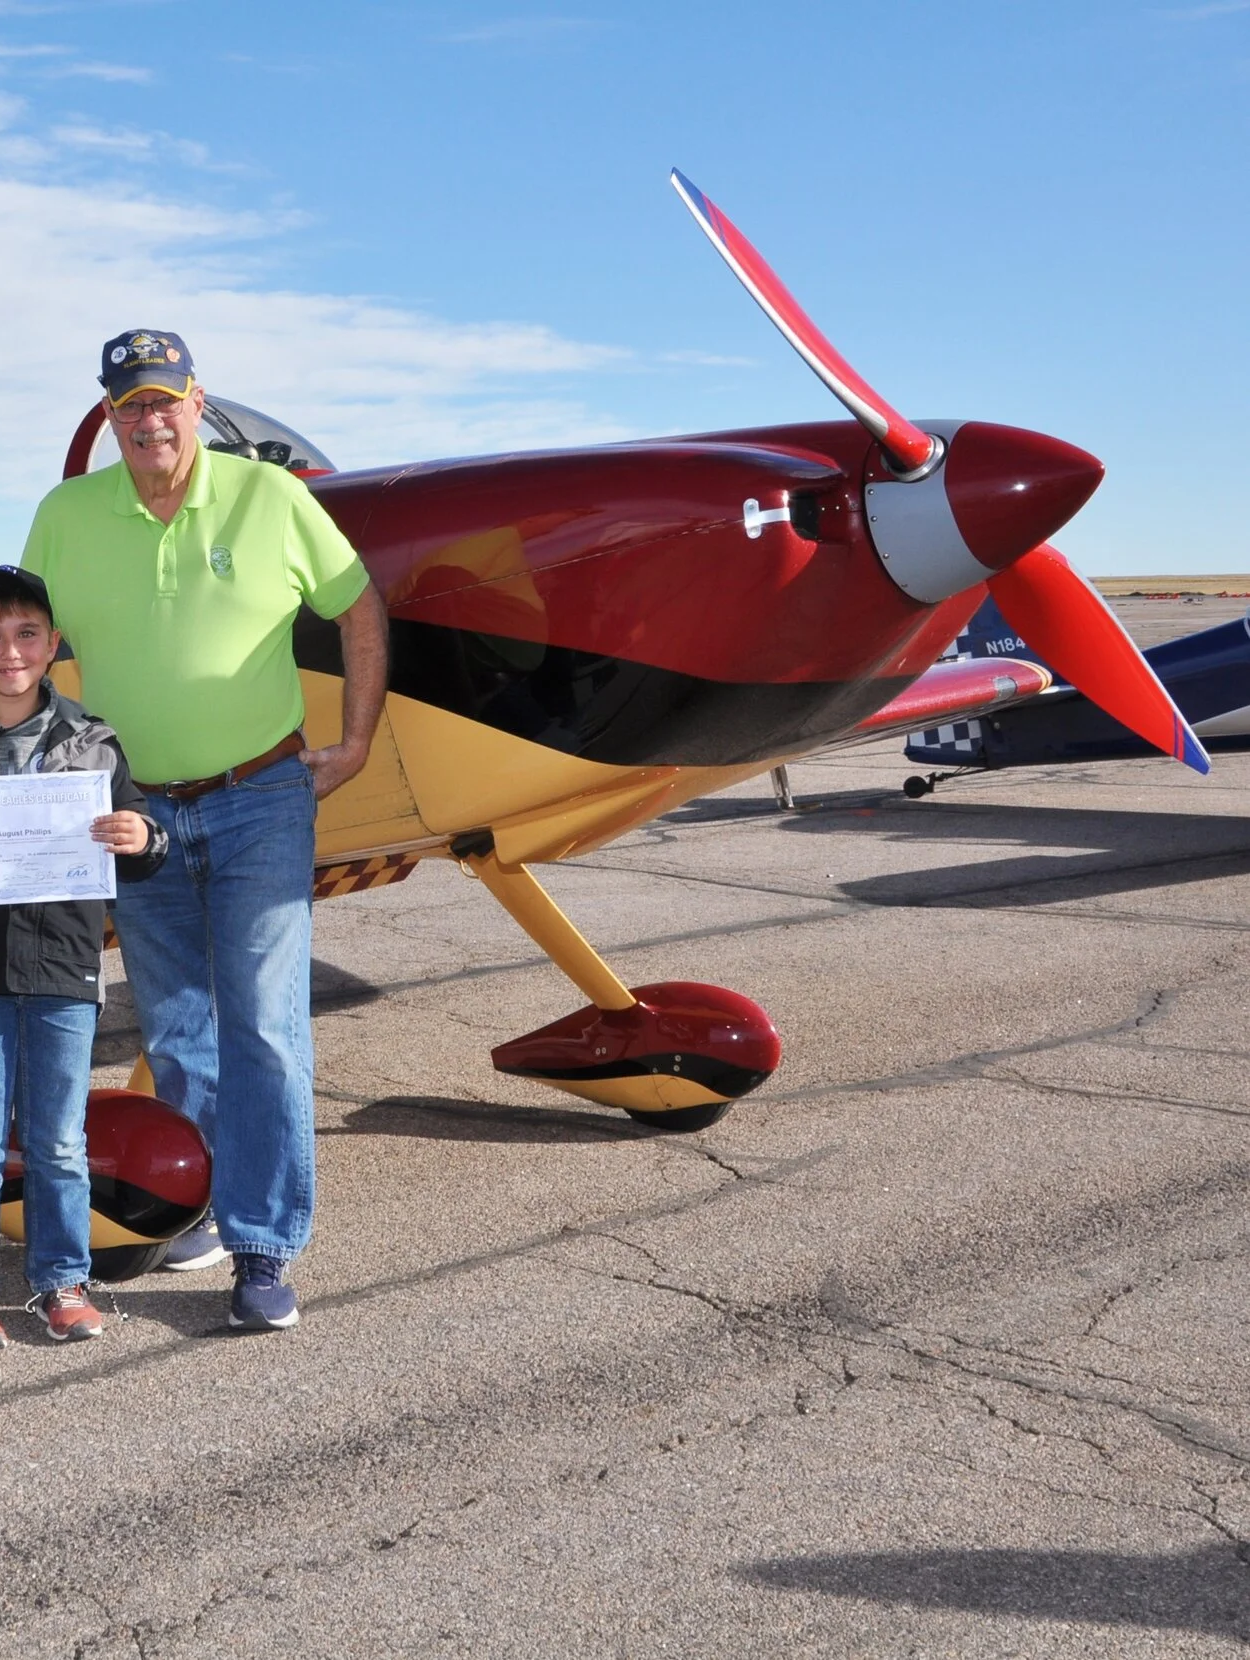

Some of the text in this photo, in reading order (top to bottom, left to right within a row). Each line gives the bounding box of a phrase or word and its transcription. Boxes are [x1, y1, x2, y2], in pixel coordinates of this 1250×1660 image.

[986, 637, 1026, 655] N184
[0, 794, 36, 807] EAGLES
[36, 791, 90, 804] CERTIFICATE
[25, 828, 52, 837] Phillips
[66, 869, 88, 878] EAA
